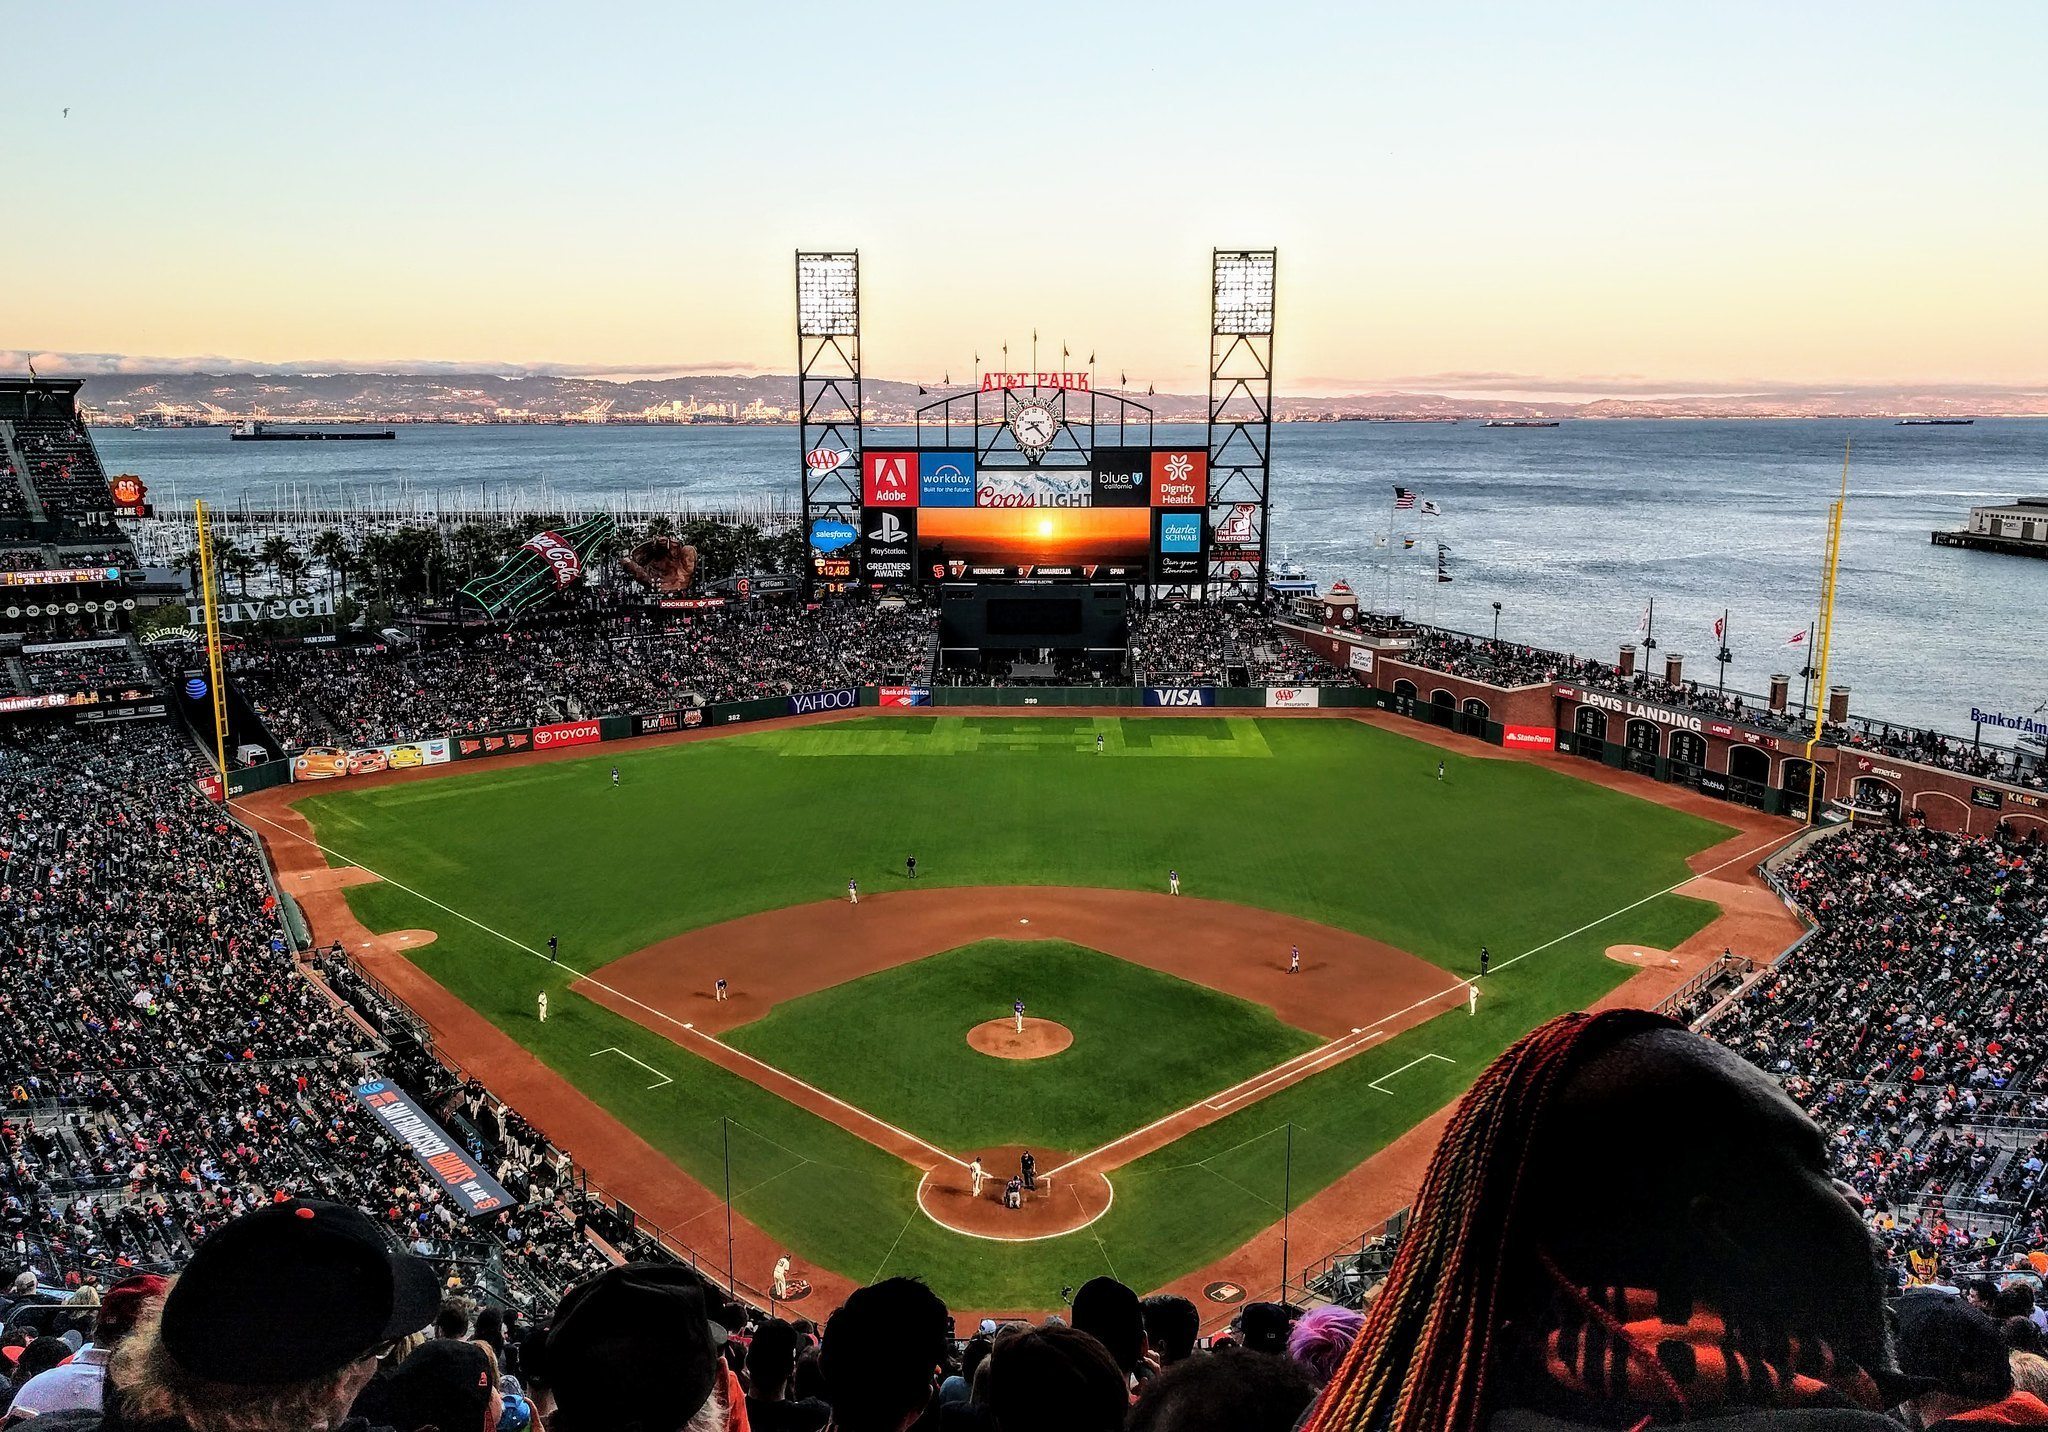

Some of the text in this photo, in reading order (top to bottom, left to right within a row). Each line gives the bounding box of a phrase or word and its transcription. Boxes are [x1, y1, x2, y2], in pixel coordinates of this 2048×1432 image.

[981, 372, 1090, 393] AT&T PARK
[1014, 442, 1055, 456] GIANTS
[811, 452, 835, 468] AAA
[1100, 472, 1129, 484] blue
[876, 490, 906, 501] Adobe
[1161, 484, 1195, 495] Dignity
[976, 486, 1091, 507] Coors LIGHT
[124, 507, 136, 516] ARE
[816, 530, 852, 540] salesforce
[1165, 525, 1196, 534] charles
[45, 571, 74, 579] Marquez
[818, 566, 850, 576] $12,428
[187, 594, 336, 625] nuveen
[139, 624, 200, 646] Ghirardelli
[881, 688, 930, 696] Bank of America
[1154, 689, 1201, 706] VISA
[792, 689, 856, 714] YAHOO!
[642, 716, 677, 729] PLAY BALL
[1626, 701, 1702, 732] LANDING
[1970, 707, 2007, 727] Bank
[2007, 716, 2022, 730] of
[553, 725, 598, 740] TOYOTA
[1871, 766, 1902, 780] america
[228, 785, 243, 795] 339
[1702, 778, 1725, 791] StubHub
[1791, 809, 1807, 820] 309
[391, 1115, 450, 1157] FRANCISCO
[427, 1151, 477, 1185] GIANTS
